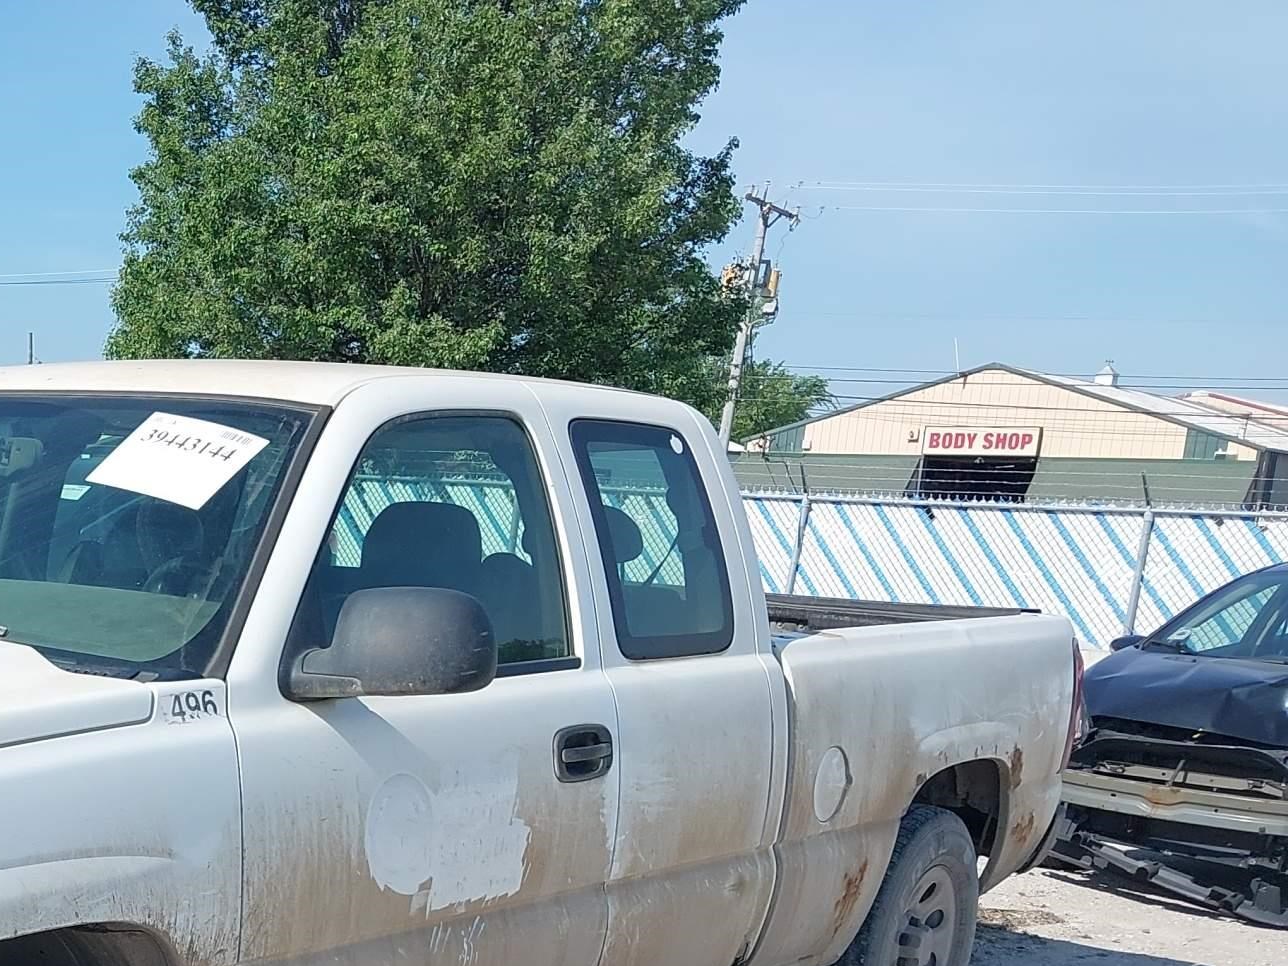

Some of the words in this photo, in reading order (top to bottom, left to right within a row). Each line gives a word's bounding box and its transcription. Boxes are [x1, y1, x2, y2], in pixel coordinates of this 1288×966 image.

[140, 429, 237, 461] 39443144
[928, 432, 978, 449] BODY
[982, 432, 1033, 450] SHOP
[171, 690, 218, 722] 496
